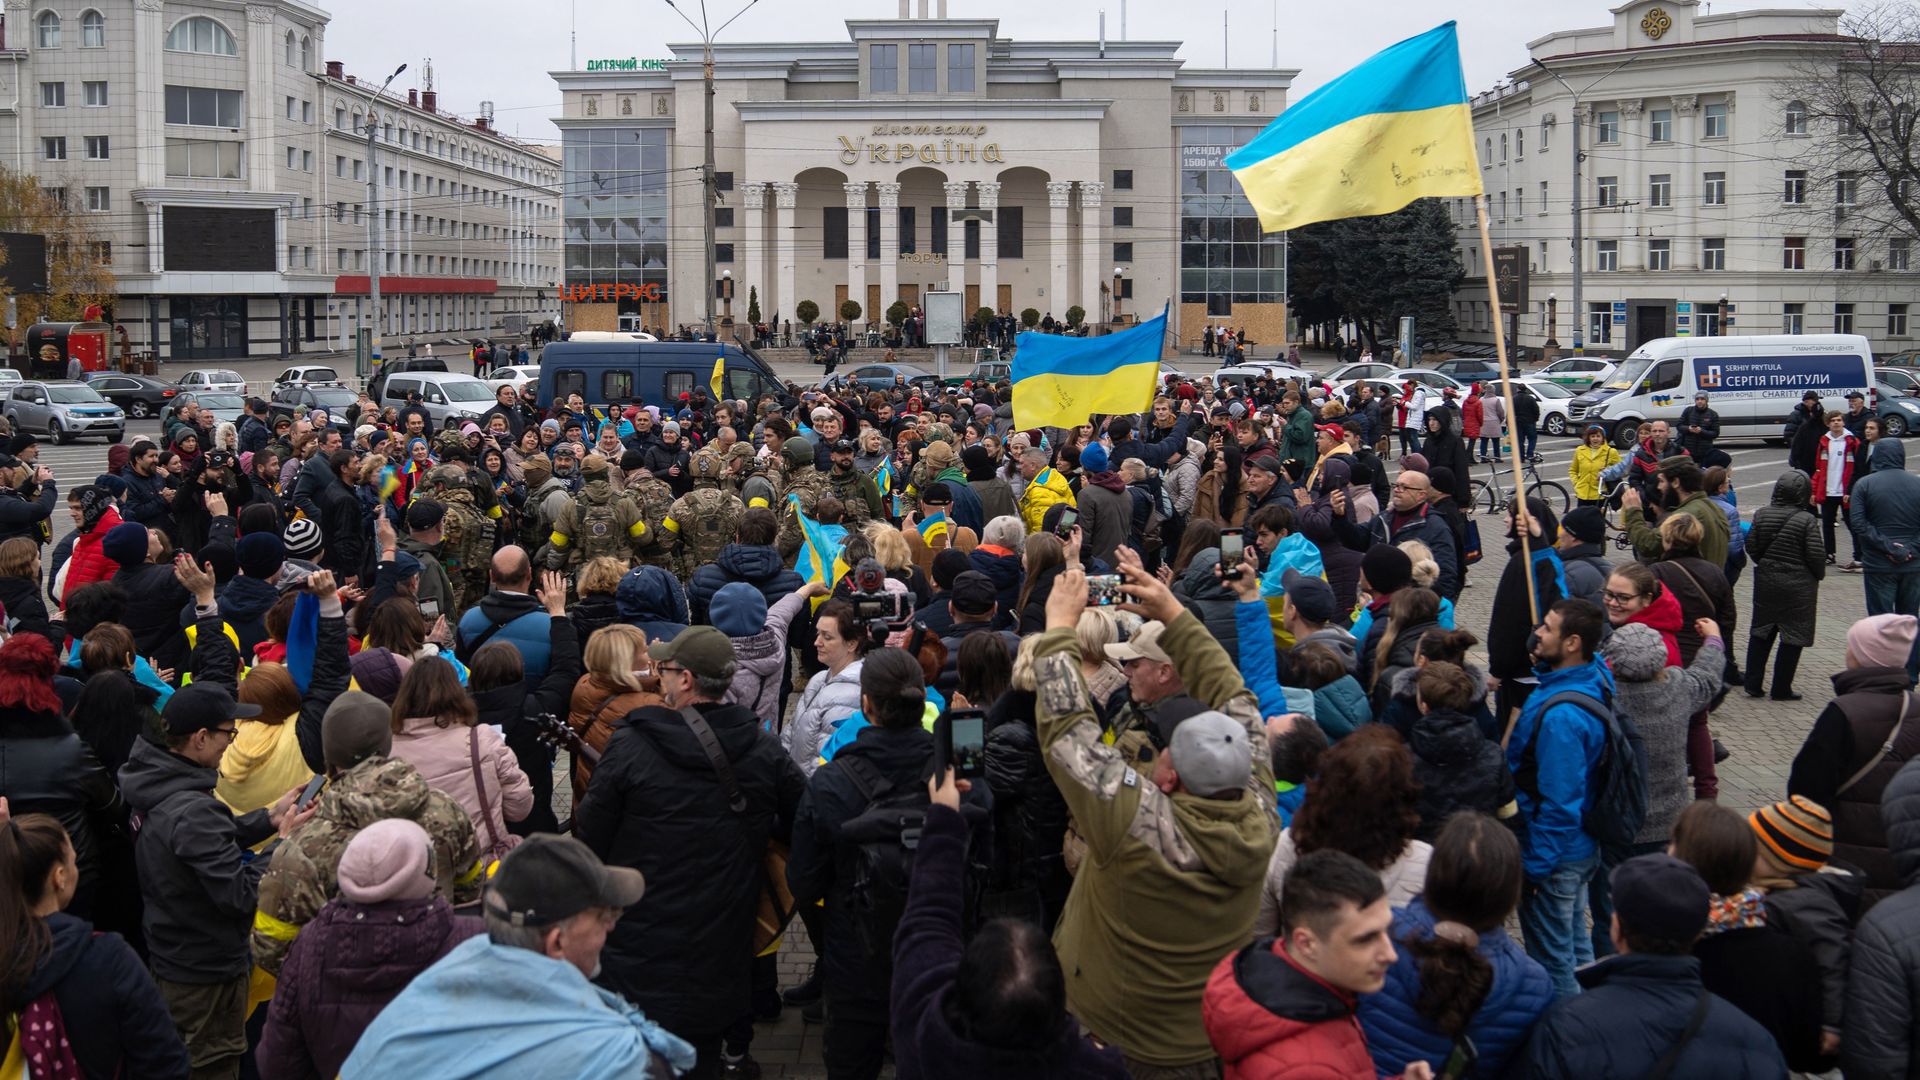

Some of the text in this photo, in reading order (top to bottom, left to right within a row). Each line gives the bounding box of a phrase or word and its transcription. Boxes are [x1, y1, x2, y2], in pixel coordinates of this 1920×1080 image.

[587, 57, 638, 70] ДИТЯЧИЙ
[837, 135, 1005, 165] Україна
[1183, 146, 1221, 155] АРЕНДА
[1183, 158, 1206, 167] 1500
[559, 283, 660, 301] ЦИТРУС
[1725, 363, 1782, 372] SERHIY PRYTULA
[1726, 374, 1830, 387] СЕРГІЯ ПРИТУЛИ
[1762, 390, 1799, 399] CHARITY
